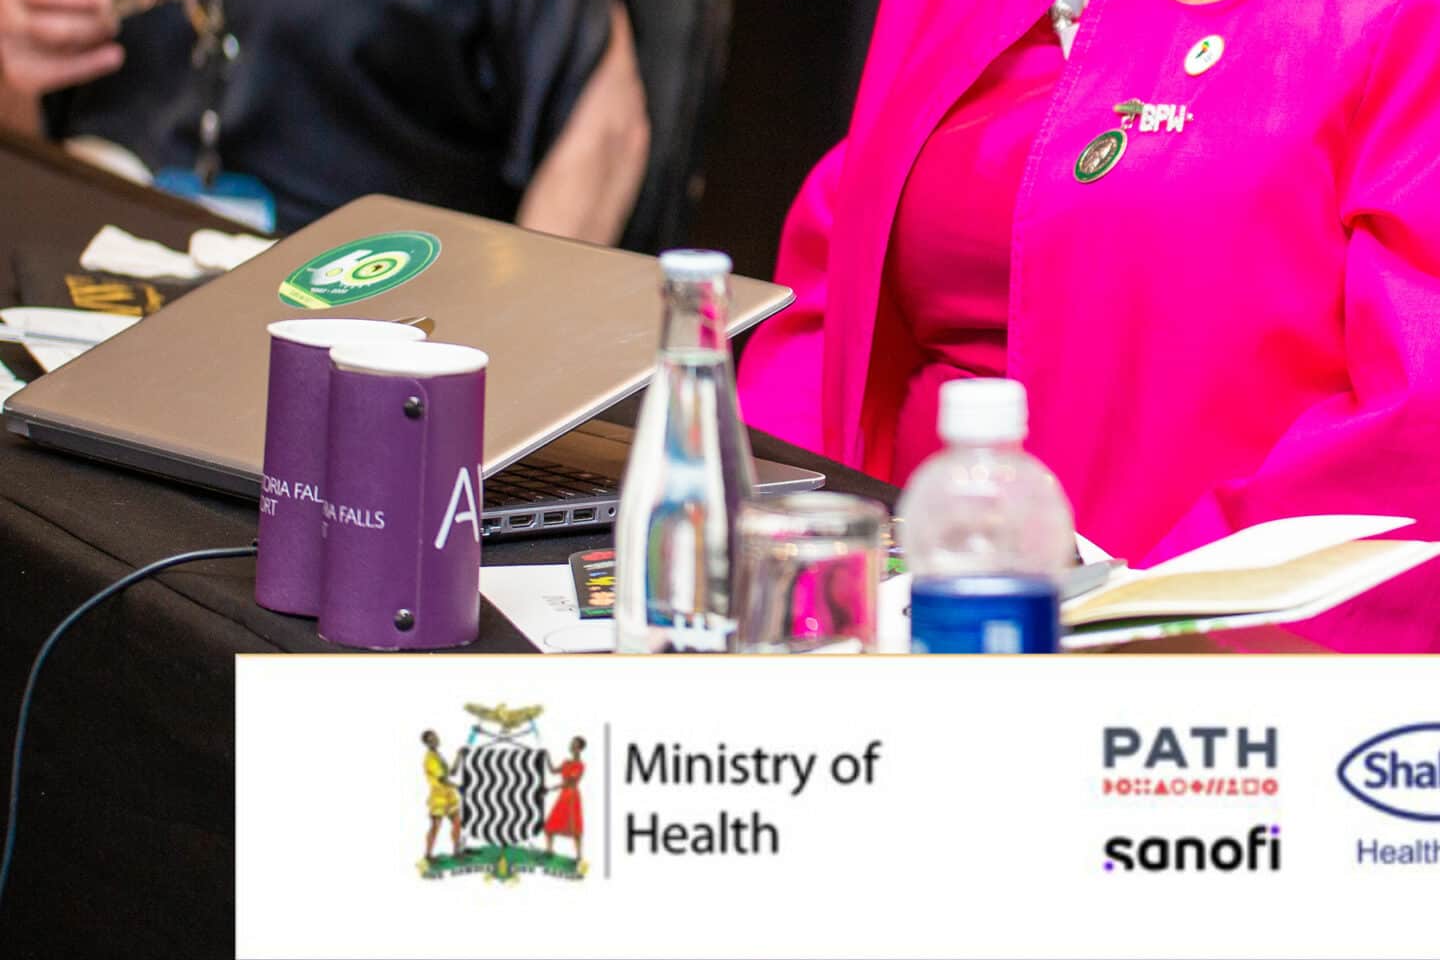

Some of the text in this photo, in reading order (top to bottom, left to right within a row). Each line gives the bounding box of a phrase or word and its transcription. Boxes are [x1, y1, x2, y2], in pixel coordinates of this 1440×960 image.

[1139, 104, 1186, 133] BPW
[338, 504, 385, 529] FALLS
[434, 463, 482, 550] A
